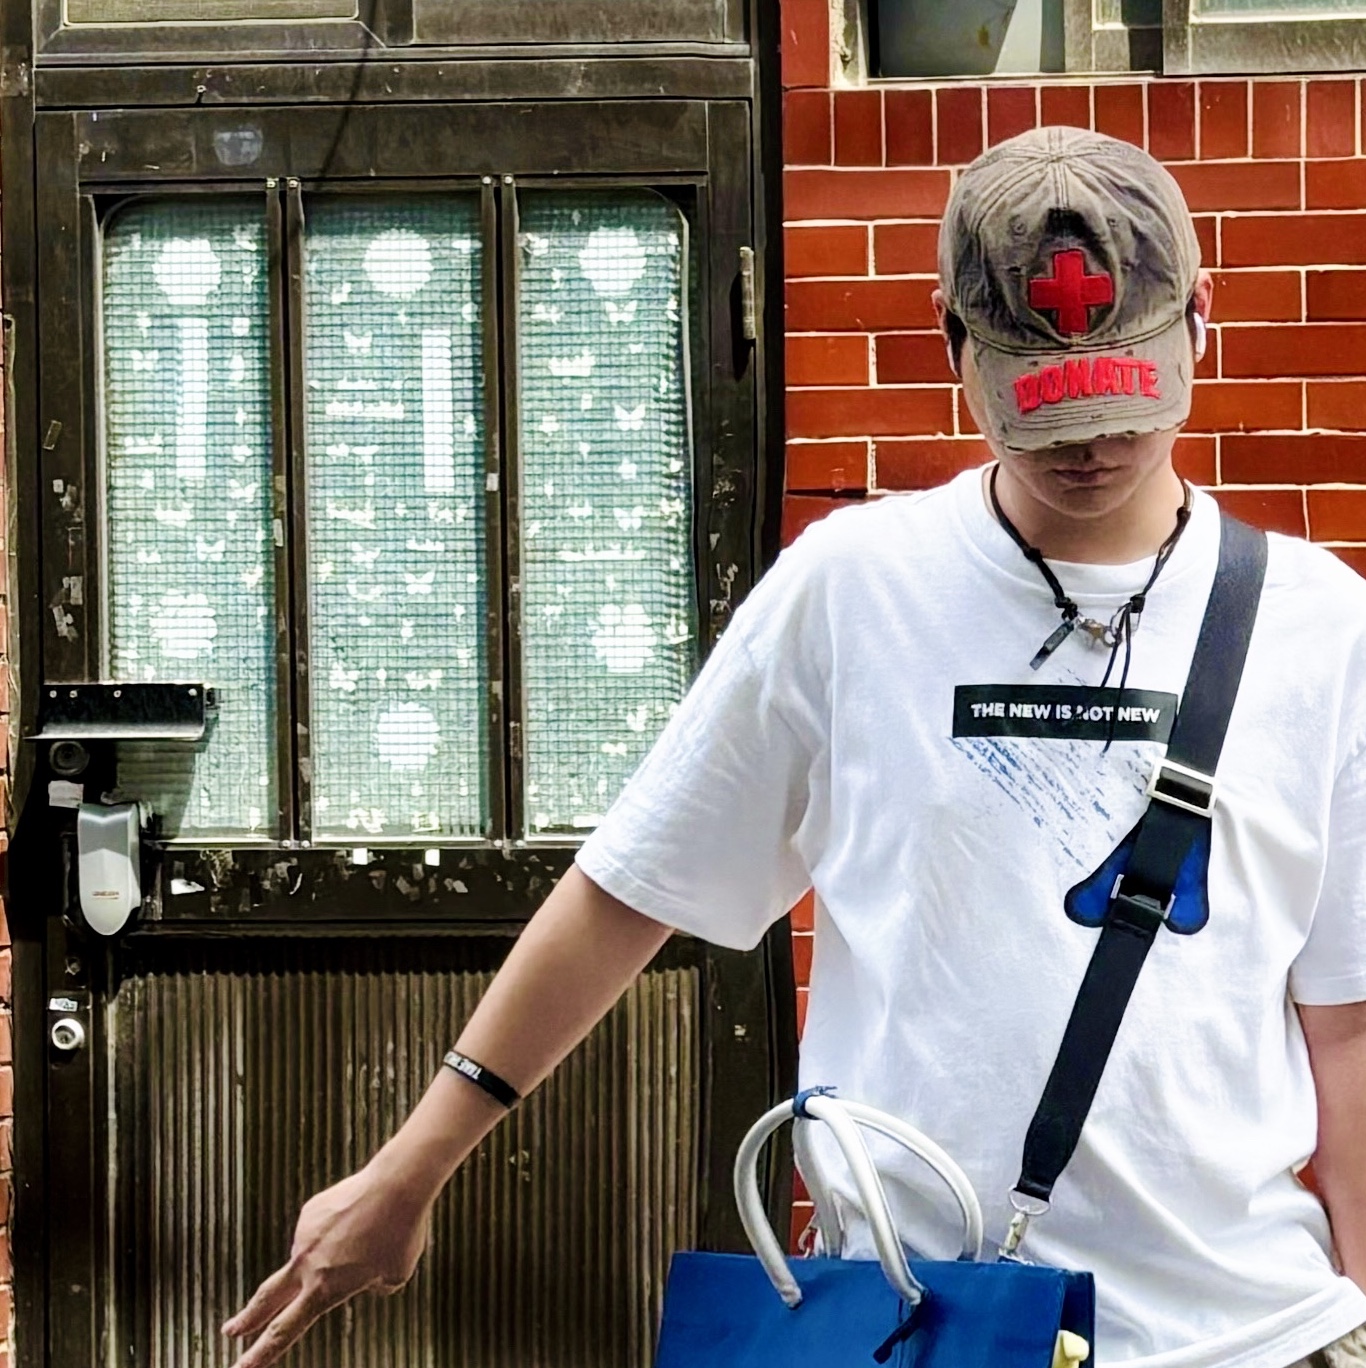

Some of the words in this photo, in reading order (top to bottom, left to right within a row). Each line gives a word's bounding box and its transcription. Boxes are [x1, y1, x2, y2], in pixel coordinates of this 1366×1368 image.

[1014, 357, 1161, 414] DONATE
[971, 703, 1005, 718] THE
[1009, 704, 1051, 720] NEW
[1055, 704, 1072, 720] IS
[1117, 706, 1160, 723] NEW
